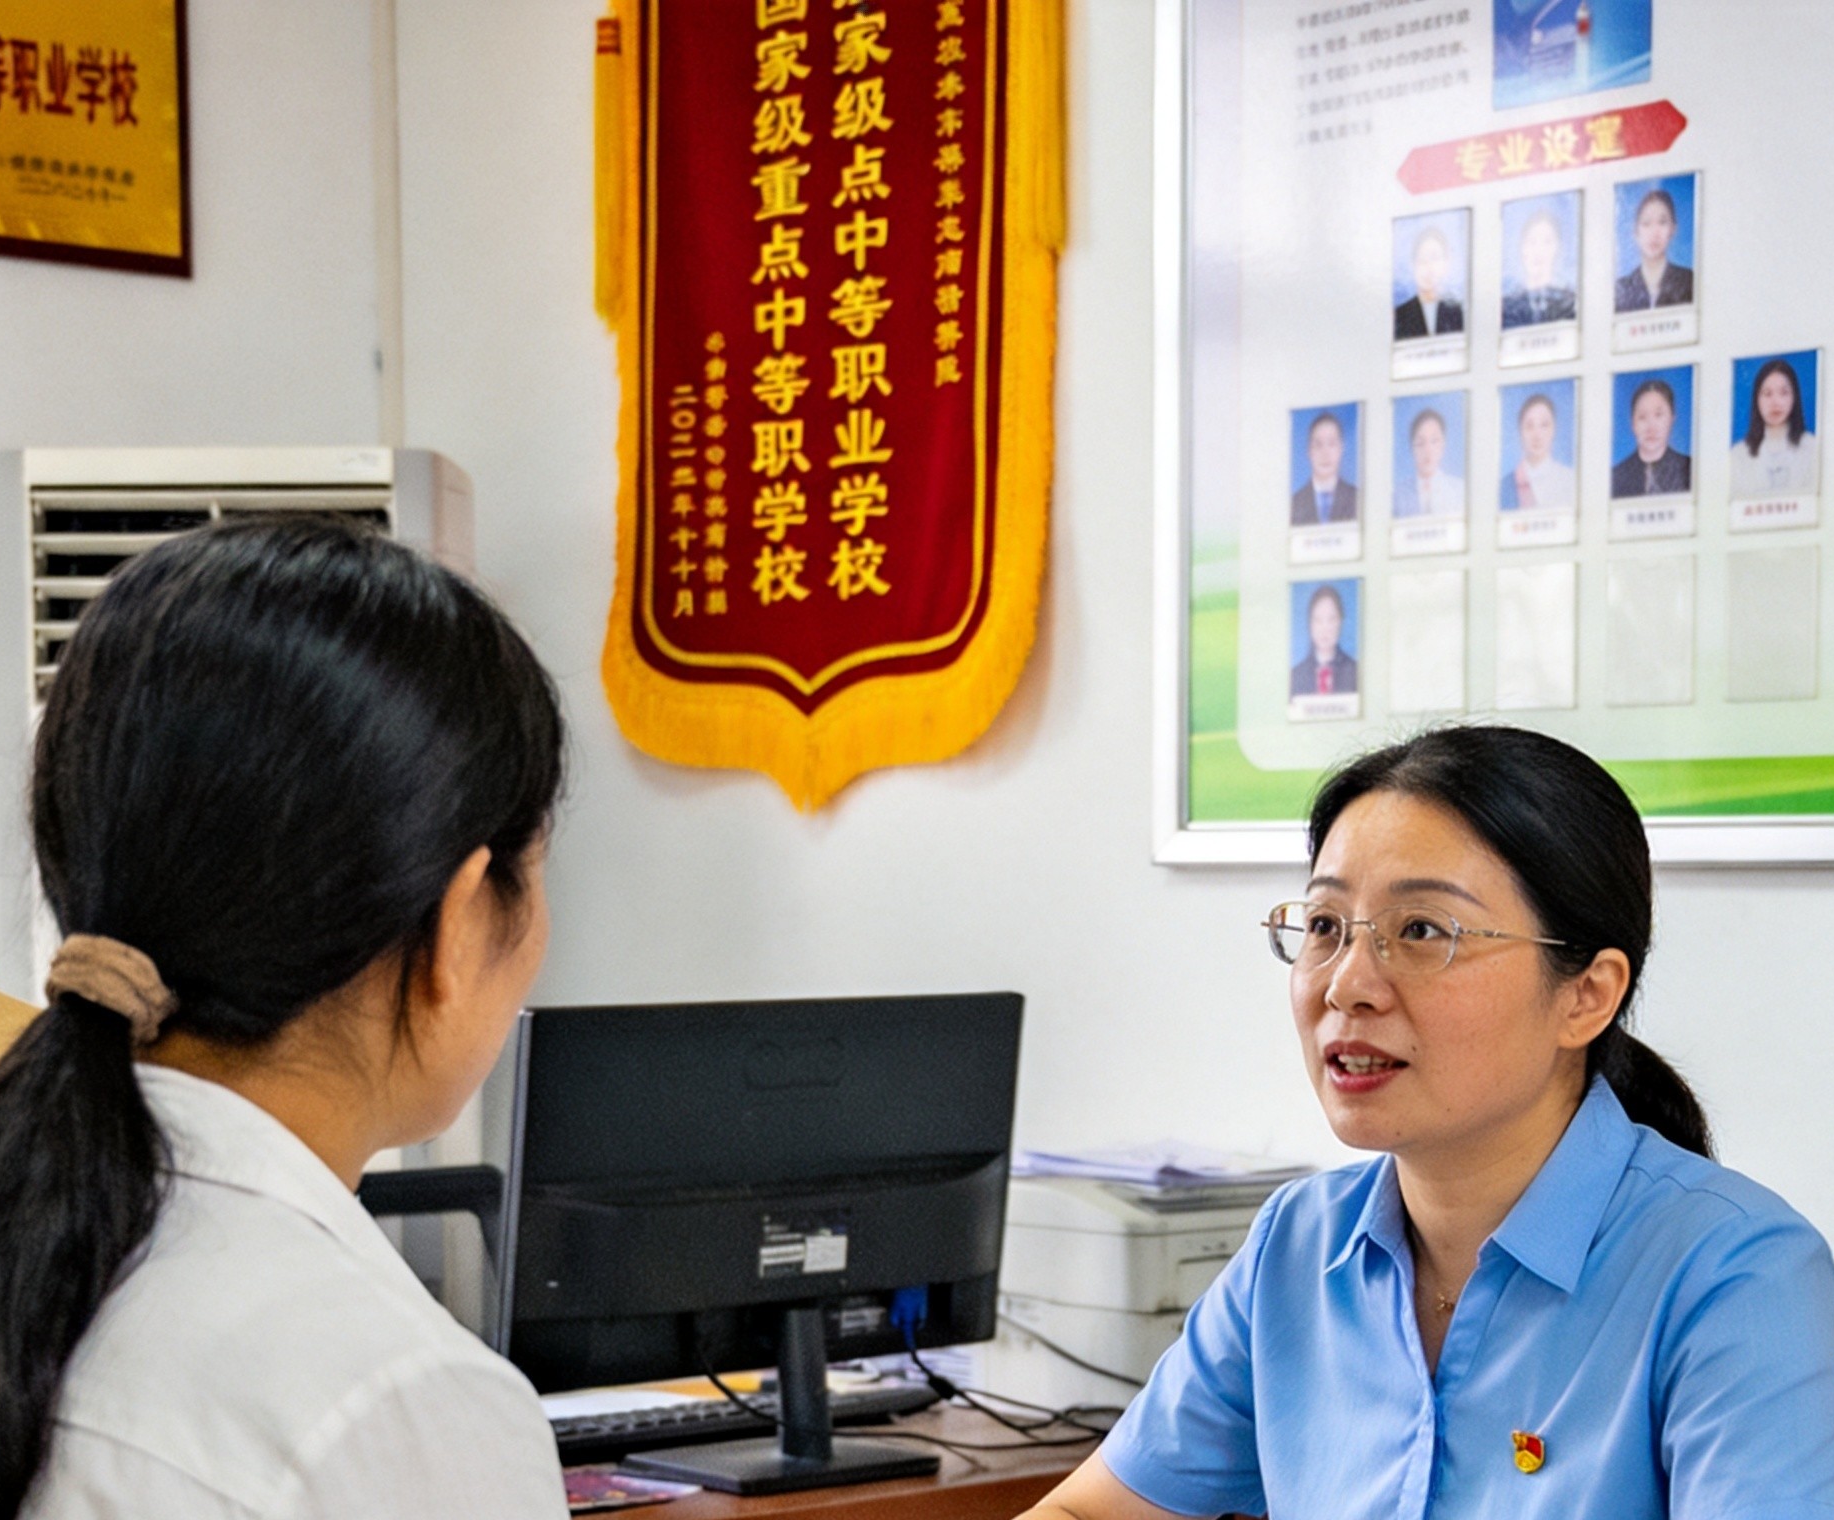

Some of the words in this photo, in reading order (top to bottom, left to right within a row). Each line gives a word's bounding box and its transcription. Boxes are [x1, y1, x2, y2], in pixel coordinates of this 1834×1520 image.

[828, 0, 893, 600] 家级点中等职业学校
